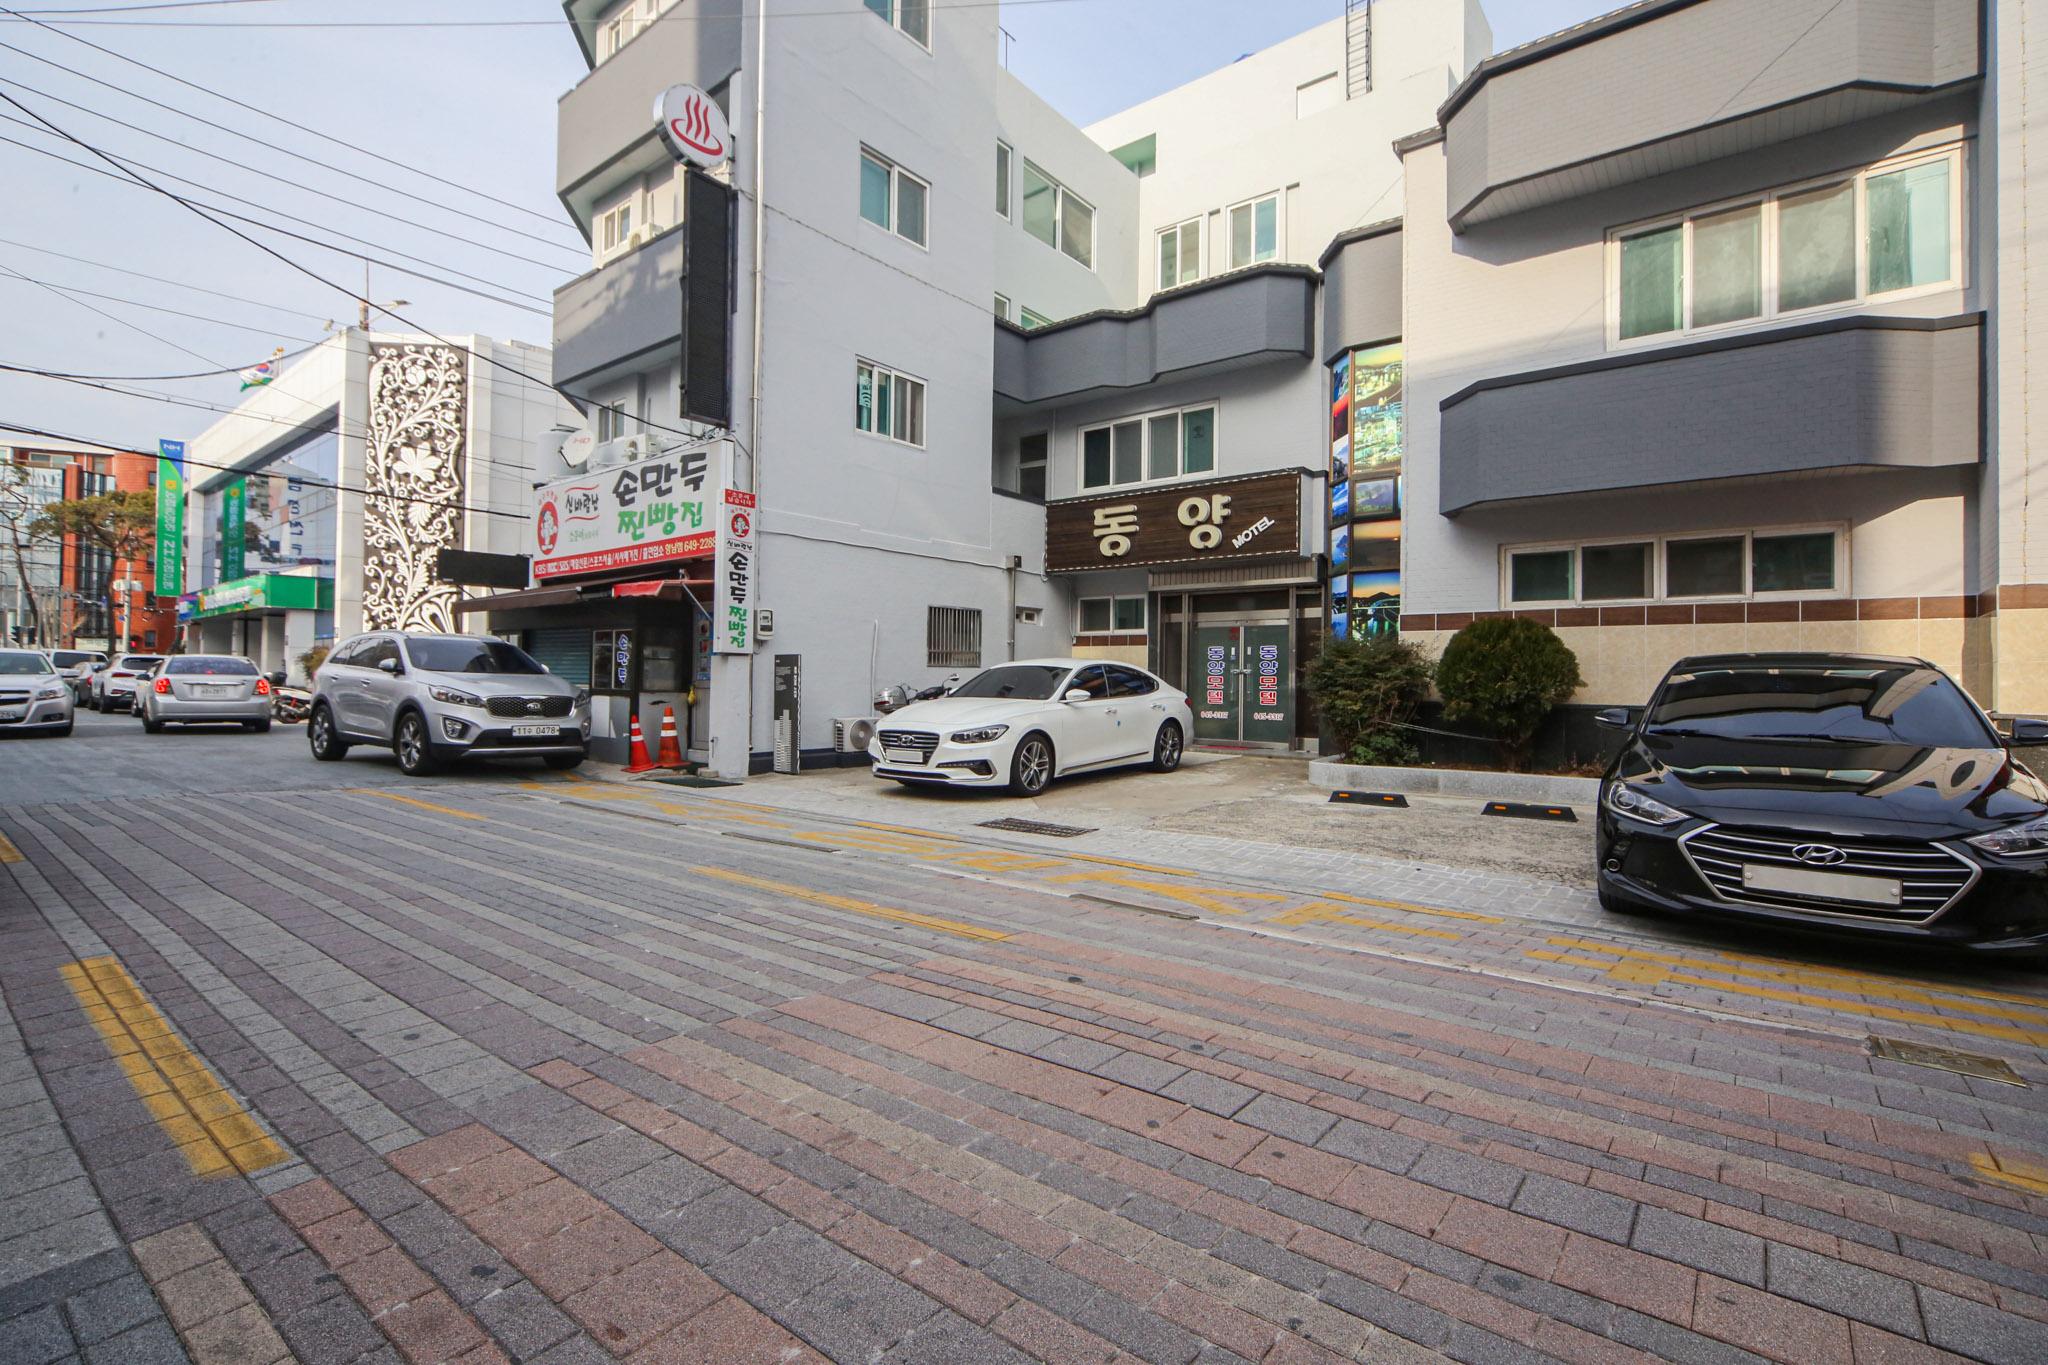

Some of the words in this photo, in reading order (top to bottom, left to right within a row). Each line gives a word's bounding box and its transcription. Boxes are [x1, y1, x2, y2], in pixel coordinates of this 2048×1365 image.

[565, 492, 599, 514] 신바람난
[612, 453, 708, 508] 손만두
[617, 501, 704, 541] 찐빵집
[1232, 516, 1275, 549] MOTEL
[728, 551, 749, 604] 손만두
[616, 633, 629, 684] 손만두
[1207, 645, 1226, 704] 동양모텔
[1259, 645, 1279, 706] 동양모텔
